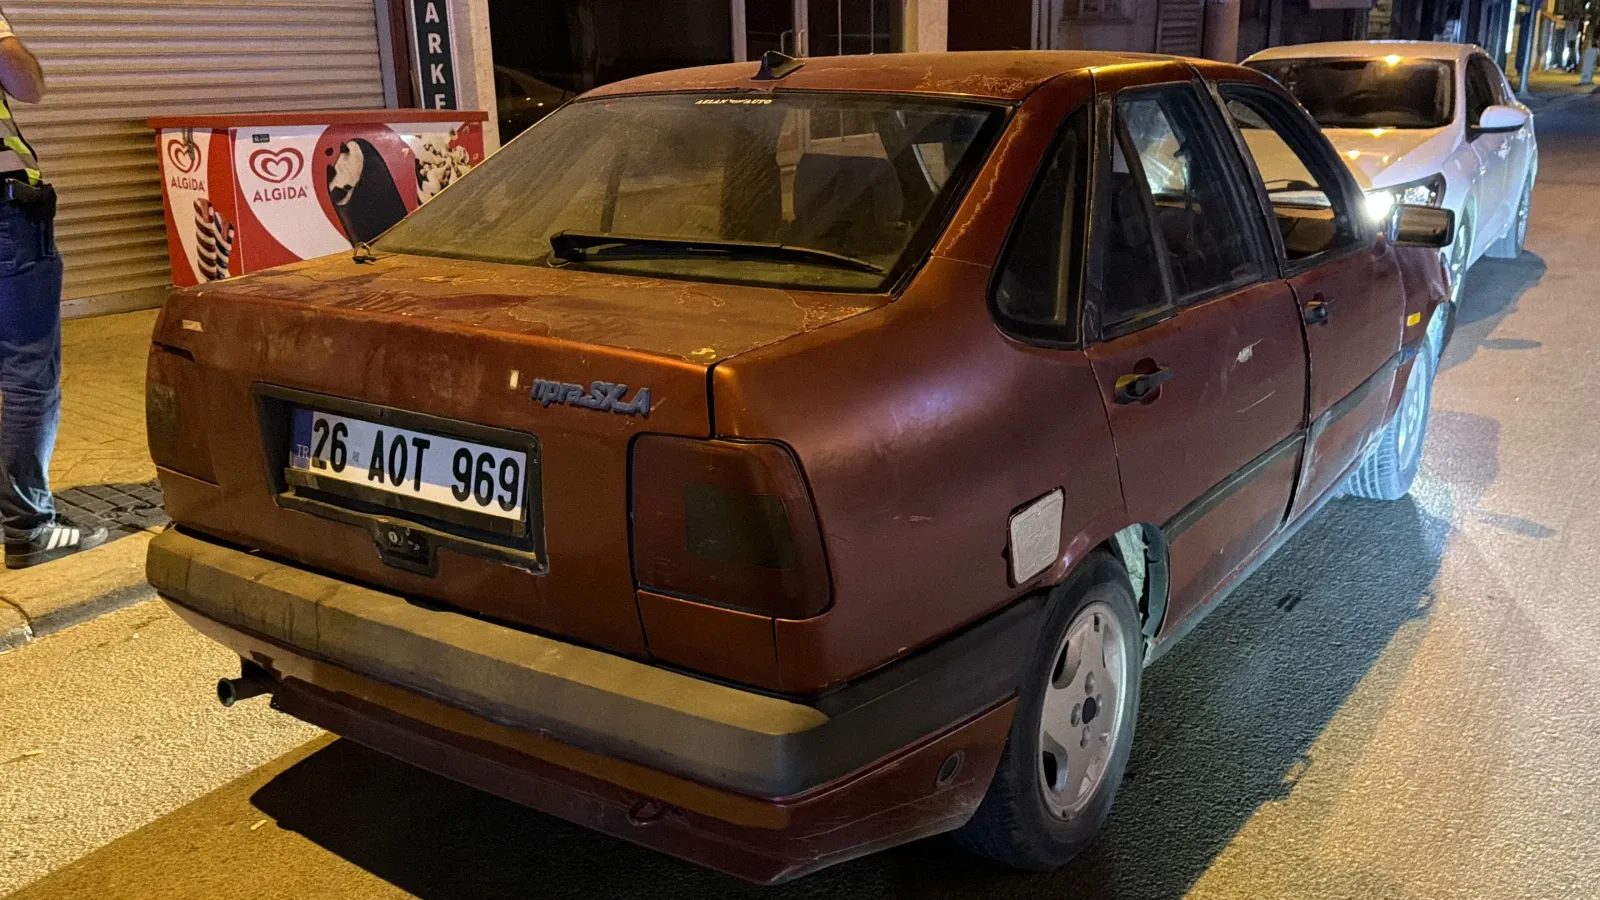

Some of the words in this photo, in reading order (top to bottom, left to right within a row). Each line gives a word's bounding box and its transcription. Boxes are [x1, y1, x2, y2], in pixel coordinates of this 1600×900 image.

[296, 443, 310, 460] TR
[312, 418, 349, 473] 26
[367, 430, 431, 492] AOT
[451, 447, 520, 512] 969
